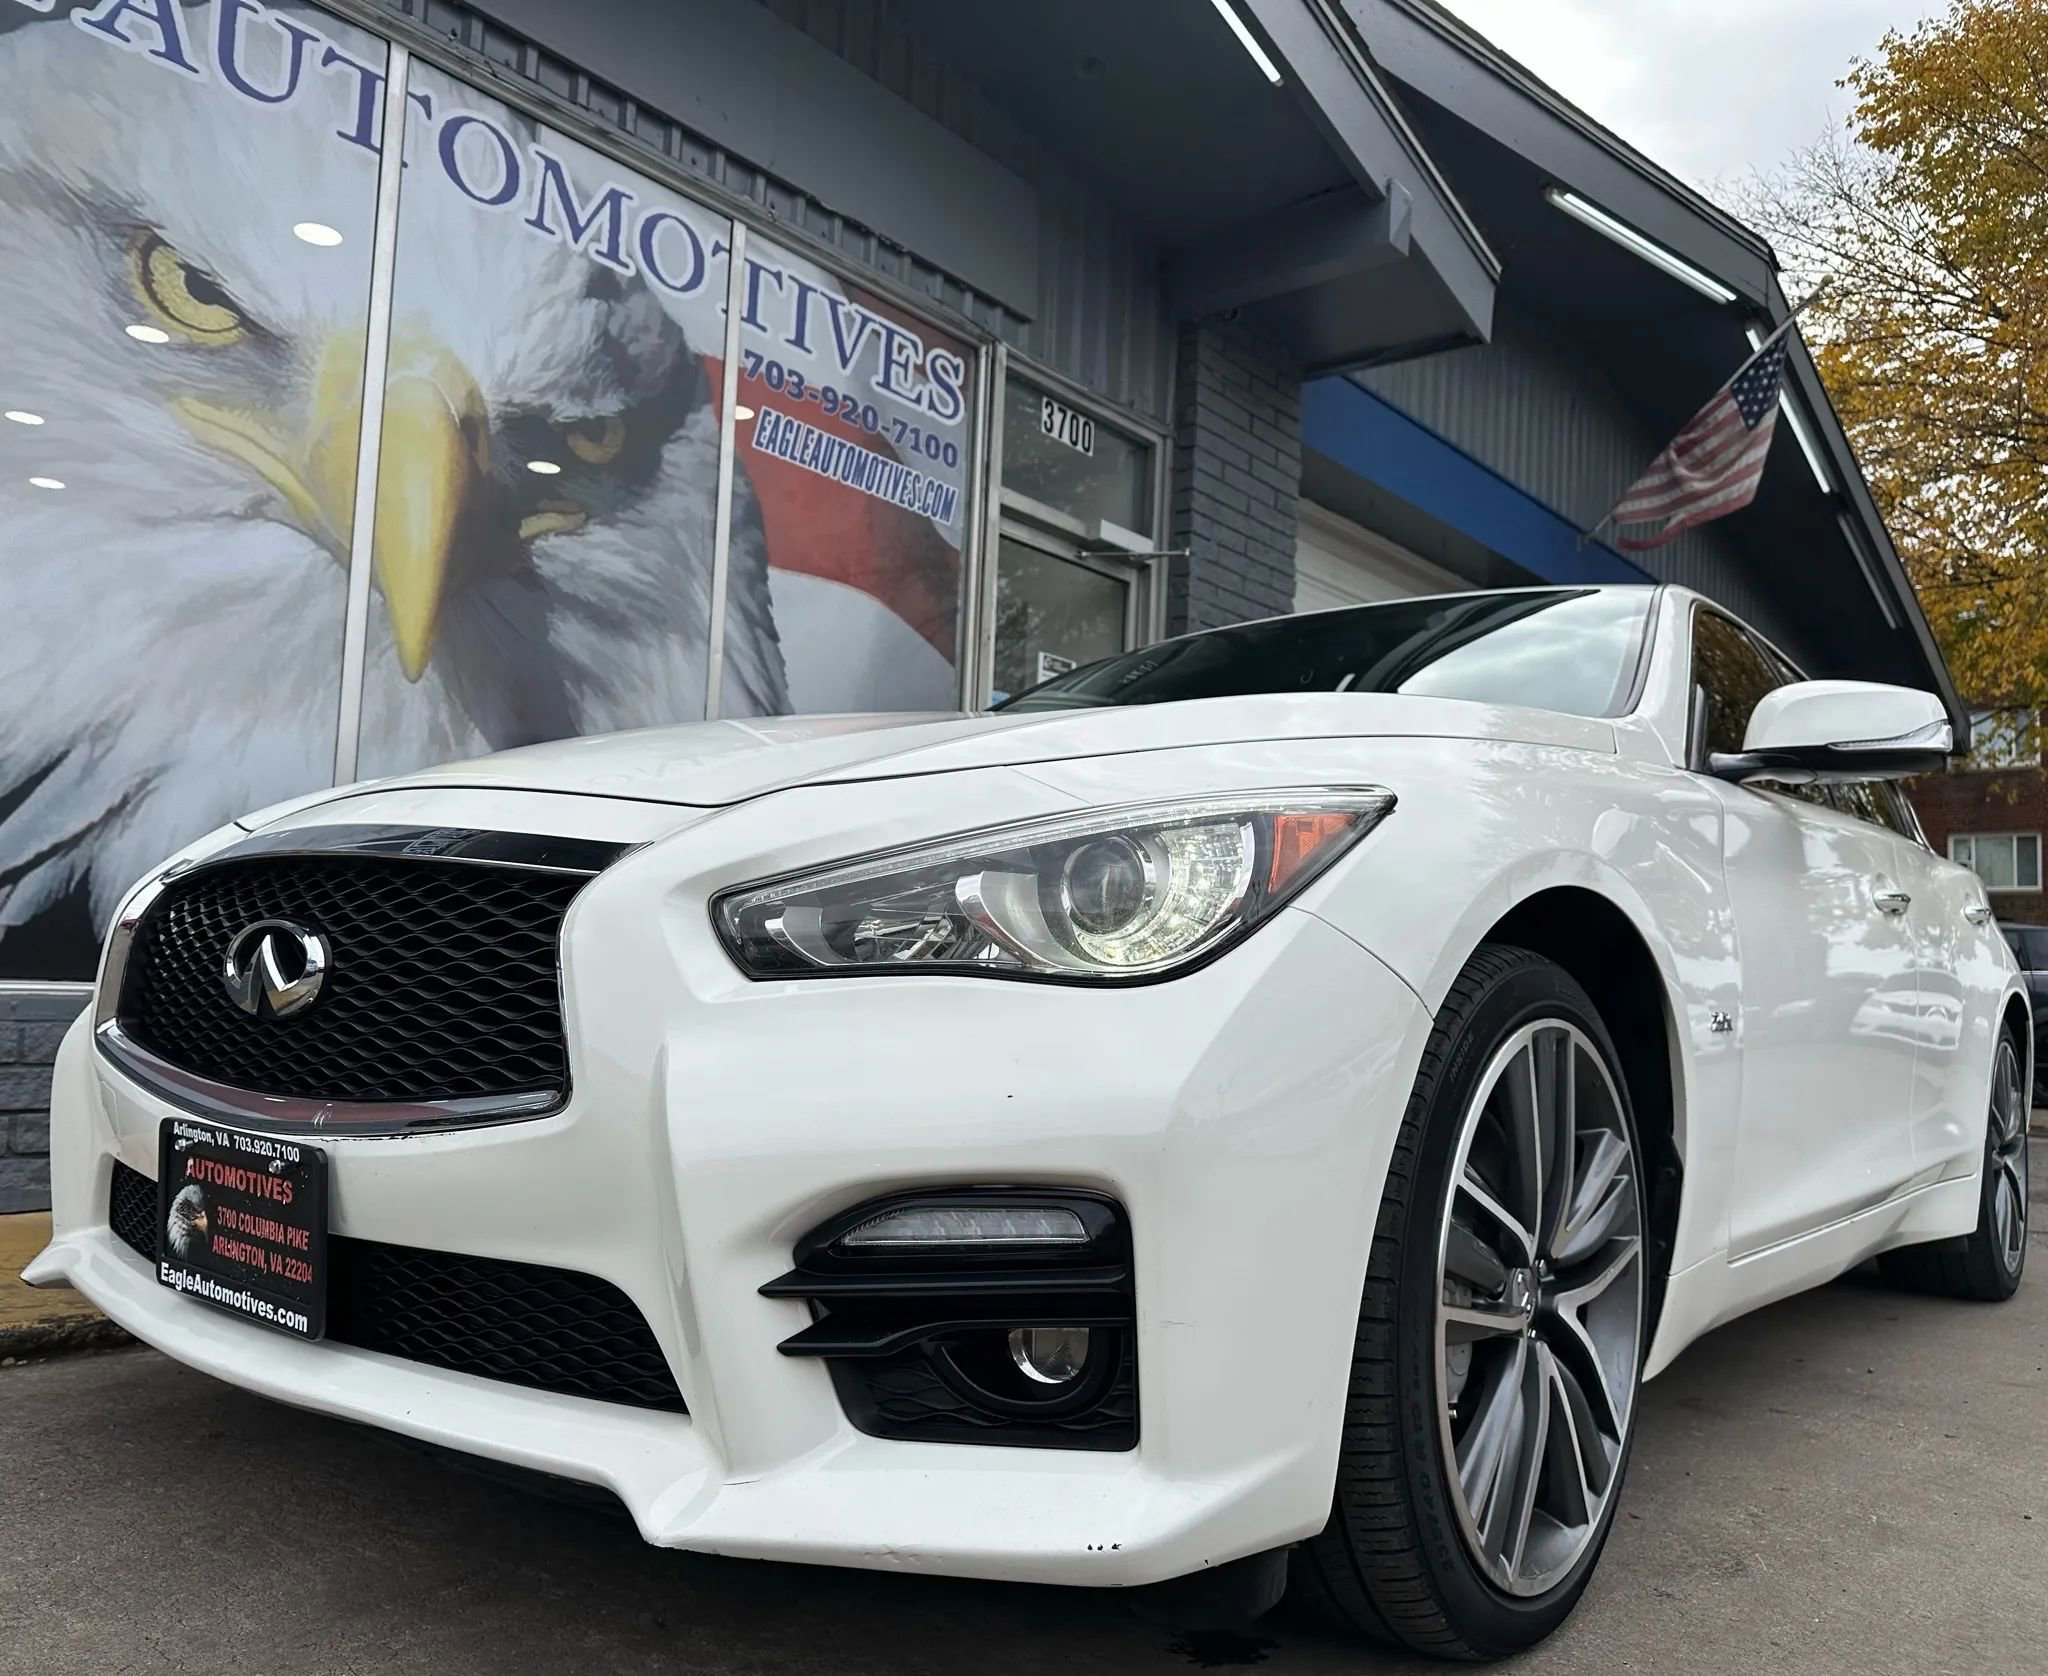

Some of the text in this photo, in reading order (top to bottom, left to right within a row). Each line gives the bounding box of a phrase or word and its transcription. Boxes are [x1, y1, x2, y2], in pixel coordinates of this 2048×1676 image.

[82, 0, 961, 420] AUTOMOTIVES
[744, 349, 959, 468] 703-920-7100
[1044, 400, 1092, 453] 3700
[754, 408, 957, 523] EAGLEAUTOMOTIVES.COM
[173, 1121, 300, 1162] Arlington, VA 703.920.7100
[186, 1158, 293, 1204] AUTOMOTIVES
[217, 1206, 310, 1251] 3700 COLUMBIA PIKE
[212, 1234, 313, 1284] ARLINGTON, VA 22204
[160, 1262, 308, 1333] EagleAutomotives.com
